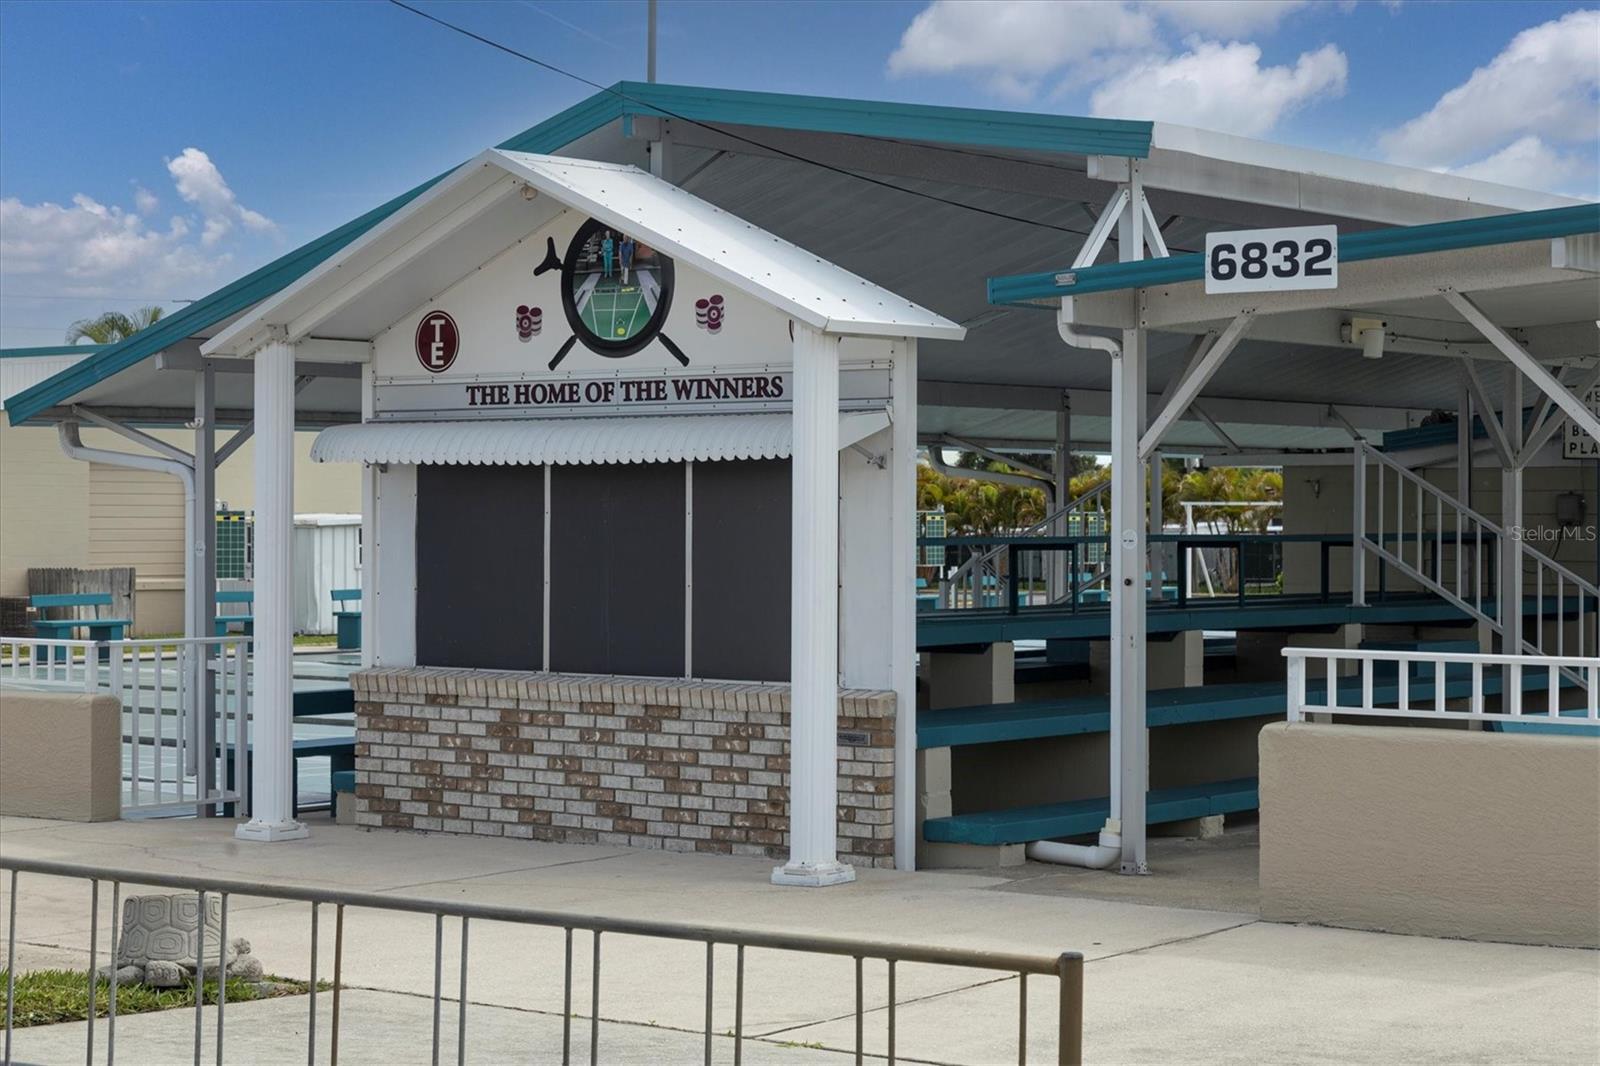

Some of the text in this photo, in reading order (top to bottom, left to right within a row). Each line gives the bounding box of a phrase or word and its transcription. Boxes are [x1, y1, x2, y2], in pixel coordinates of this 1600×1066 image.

[1210, 238, 1333, 281] 6832
[465, 375, 784, 406] THE HOME OF THE WINNERS
